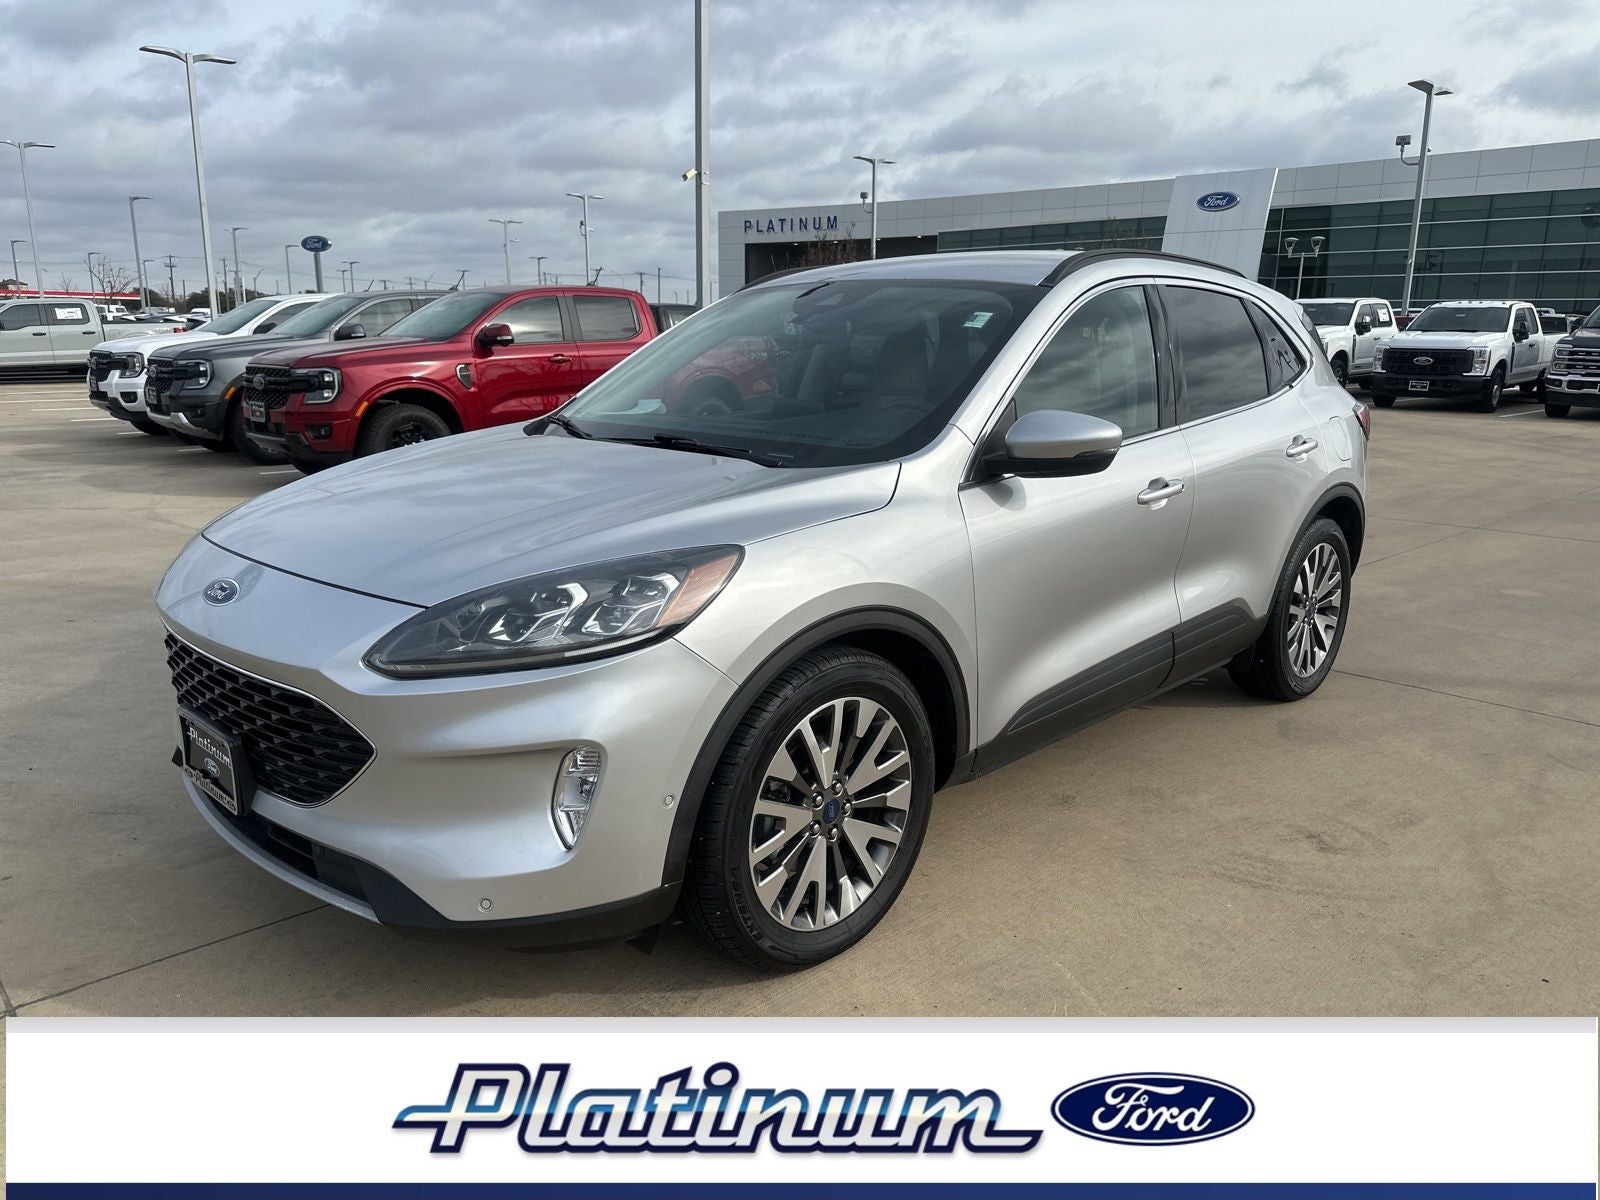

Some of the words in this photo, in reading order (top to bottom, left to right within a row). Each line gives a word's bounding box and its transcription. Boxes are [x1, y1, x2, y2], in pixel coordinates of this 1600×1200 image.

[1204, 195, 1229, 207] Ford
[743, 215, 838, 233] PLATINUM
[207, 581, 230, 600] Ford
